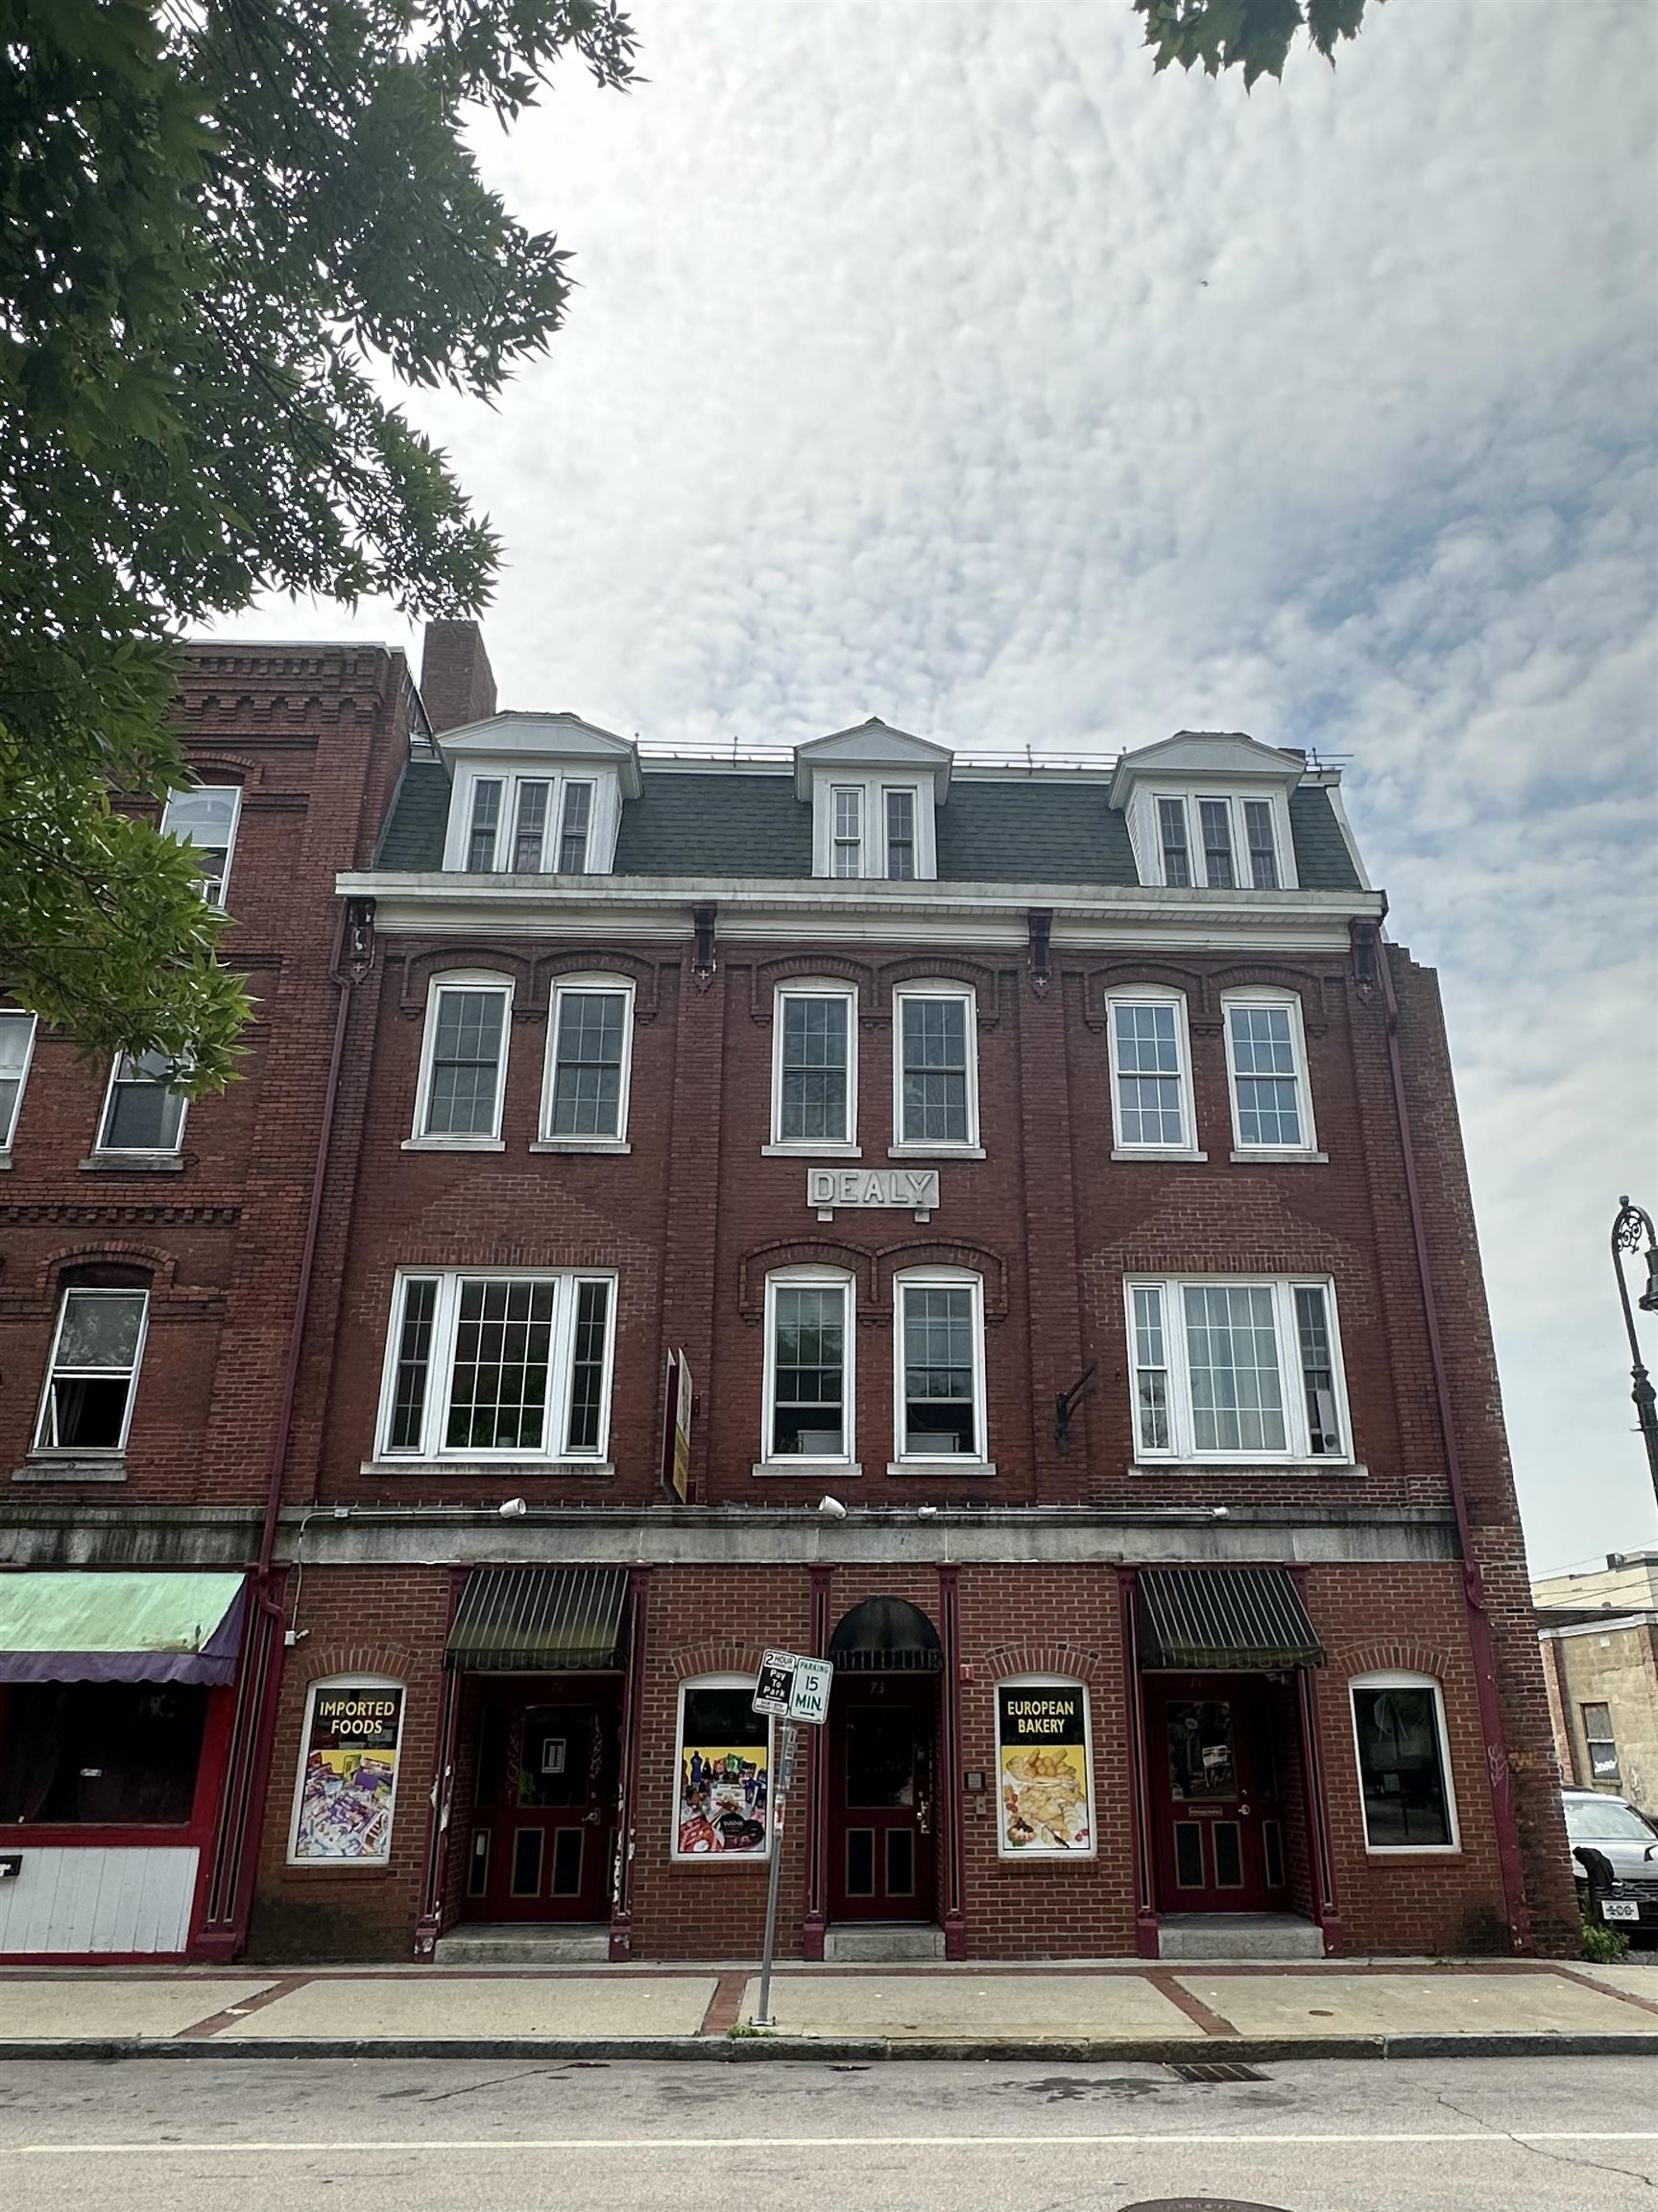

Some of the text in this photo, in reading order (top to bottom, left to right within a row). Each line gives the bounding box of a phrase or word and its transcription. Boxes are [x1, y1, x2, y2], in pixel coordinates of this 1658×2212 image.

[813, 1171, 933, 1204] DEALY
[766, 1654, 794, 1665] 2 HOUR
[800, 1661, 829, 1673] PARKING
[770, 1670, 786, 1681] Pay
[805, 1675, 819, 1691] 15
[772, 1679, 781, 1688] To
[763, 1686, 785, 1697] Park
[320, 1701, 395, 1716] IMPORTED
[1007, 1700, 1074, 1716] EUROPEAN
[330, 1719, 383, 1735] FOODS
[1018, 1719, 1065, 1734] BAKERY
